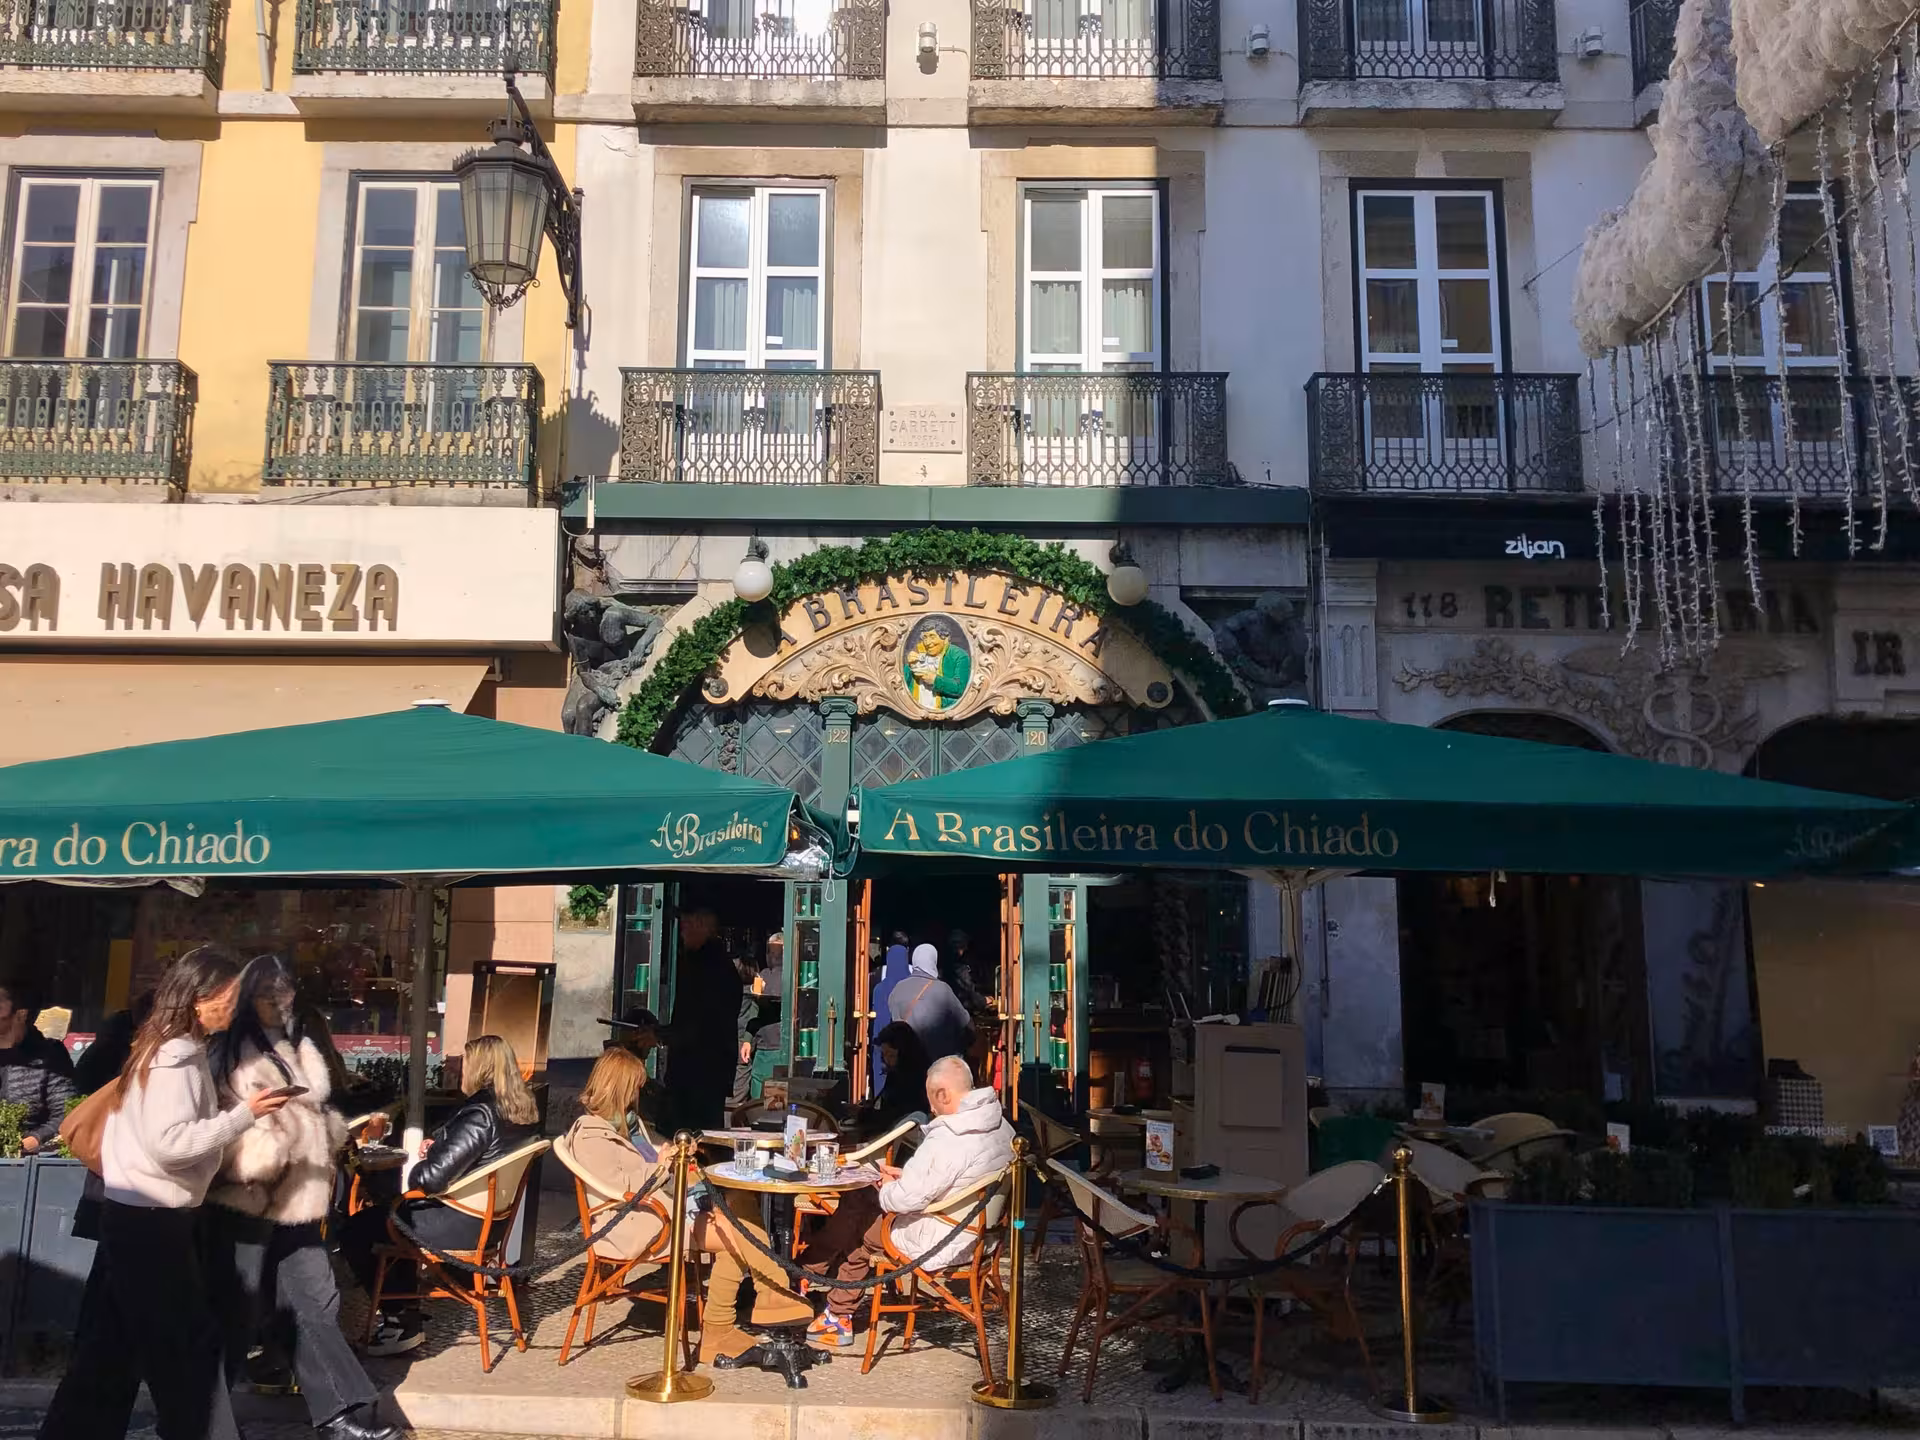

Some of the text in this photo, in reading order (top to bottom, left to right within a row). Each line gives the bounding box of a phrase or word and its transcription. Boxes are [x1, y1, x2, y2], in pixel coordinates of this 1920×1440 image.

[889, 420, 958, 433] GARRETT
[910, 409, 936, 418] RUA
[1505, 532, 1566, 559] zilian
[0, 562, 400, 632] SA HAVANEZA
[1403, 592, 1458, 618] 118
[804, 574, 1109, 659] BRASILEIRA
[828, 728, 848, 744] 122
[1025, 731, 1046, 746] 120
[54, 822, 105, 866] do
[121, 820, 271, 867] Chiado
[650, 811, 762, 859] A Brasileira
[884, 808, 1400, 858] A Brasileira do Chiado
[1763, 1125, 1848, 1138] SHOP ONLINE
